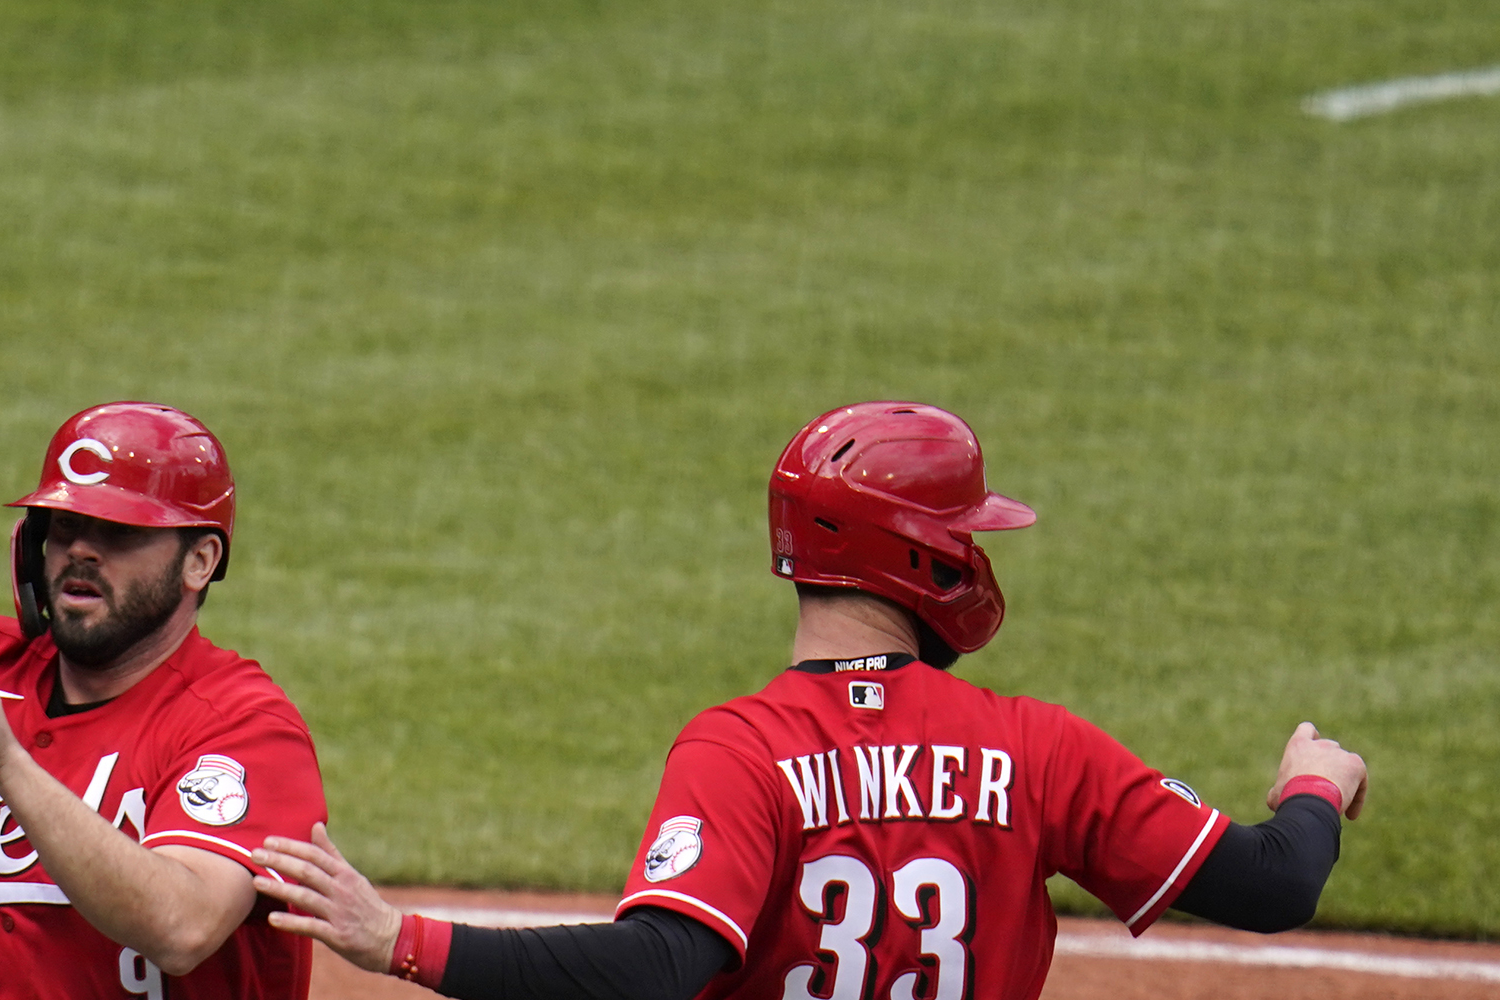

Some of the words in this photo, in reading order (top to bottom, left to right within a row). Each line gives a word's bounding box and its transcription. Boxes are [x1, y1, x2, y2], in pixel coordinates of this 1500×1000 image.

[57, 438, 114, 486] C
[834, 658, 865, 673] NIKE
[866, 655, 888, 671] PRO
[777, 745, 1013, 830] WINKER
